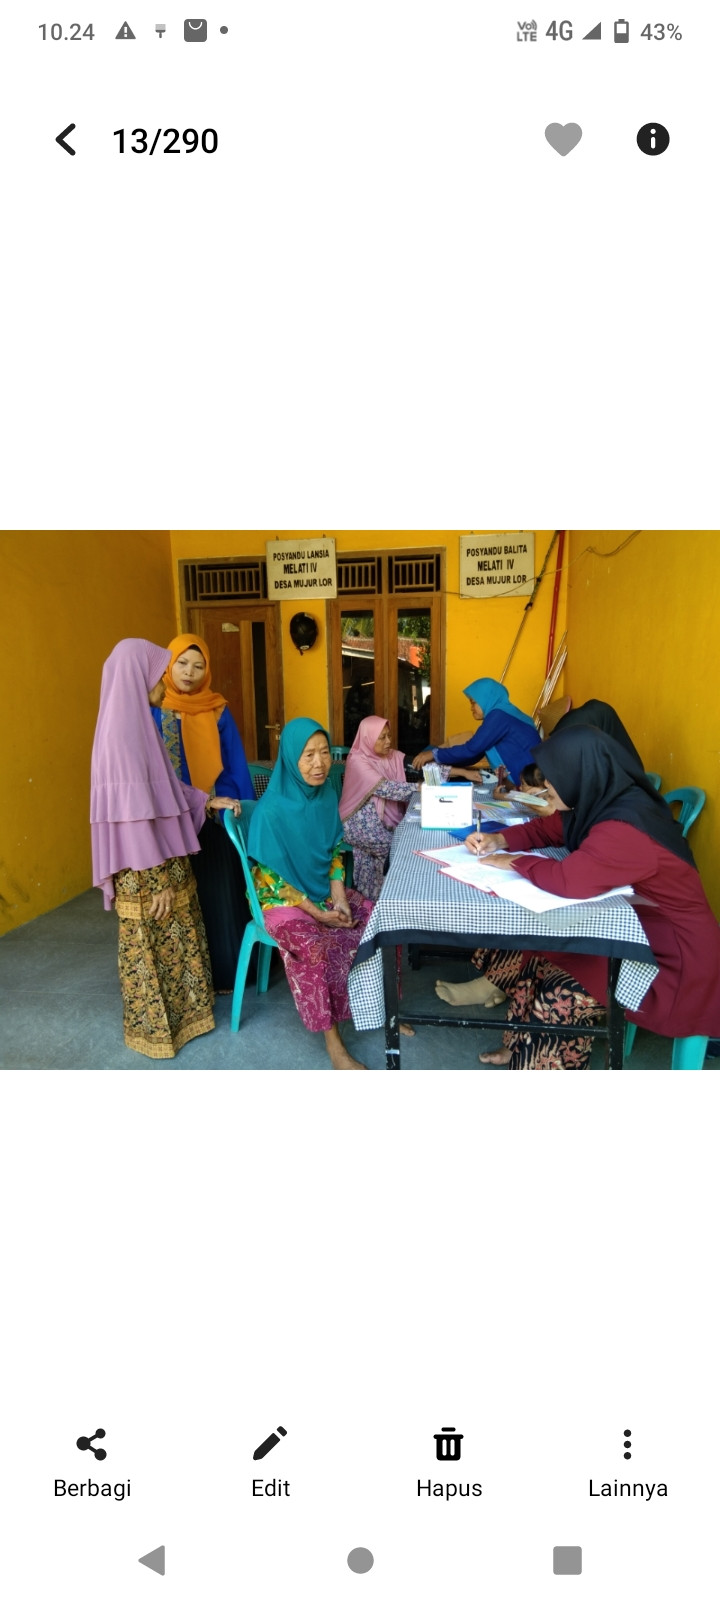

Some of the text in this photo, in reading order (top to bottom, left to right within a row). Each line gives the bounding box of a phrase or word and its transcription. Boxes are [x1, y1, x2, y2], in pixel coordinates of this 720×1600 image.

[273, 549, 330, 561] POSYANDU LANSIA
[466, 544, 528, 557] POSYANDU BALITA
[283, 562, 318, 575] MELATI IV
[477, 558, 515, 572] MELATI IV
[274, 577, 333, 589] DESA MUJUR LOR
[466, 574, 528, 586] DESA MUJUR LOR
